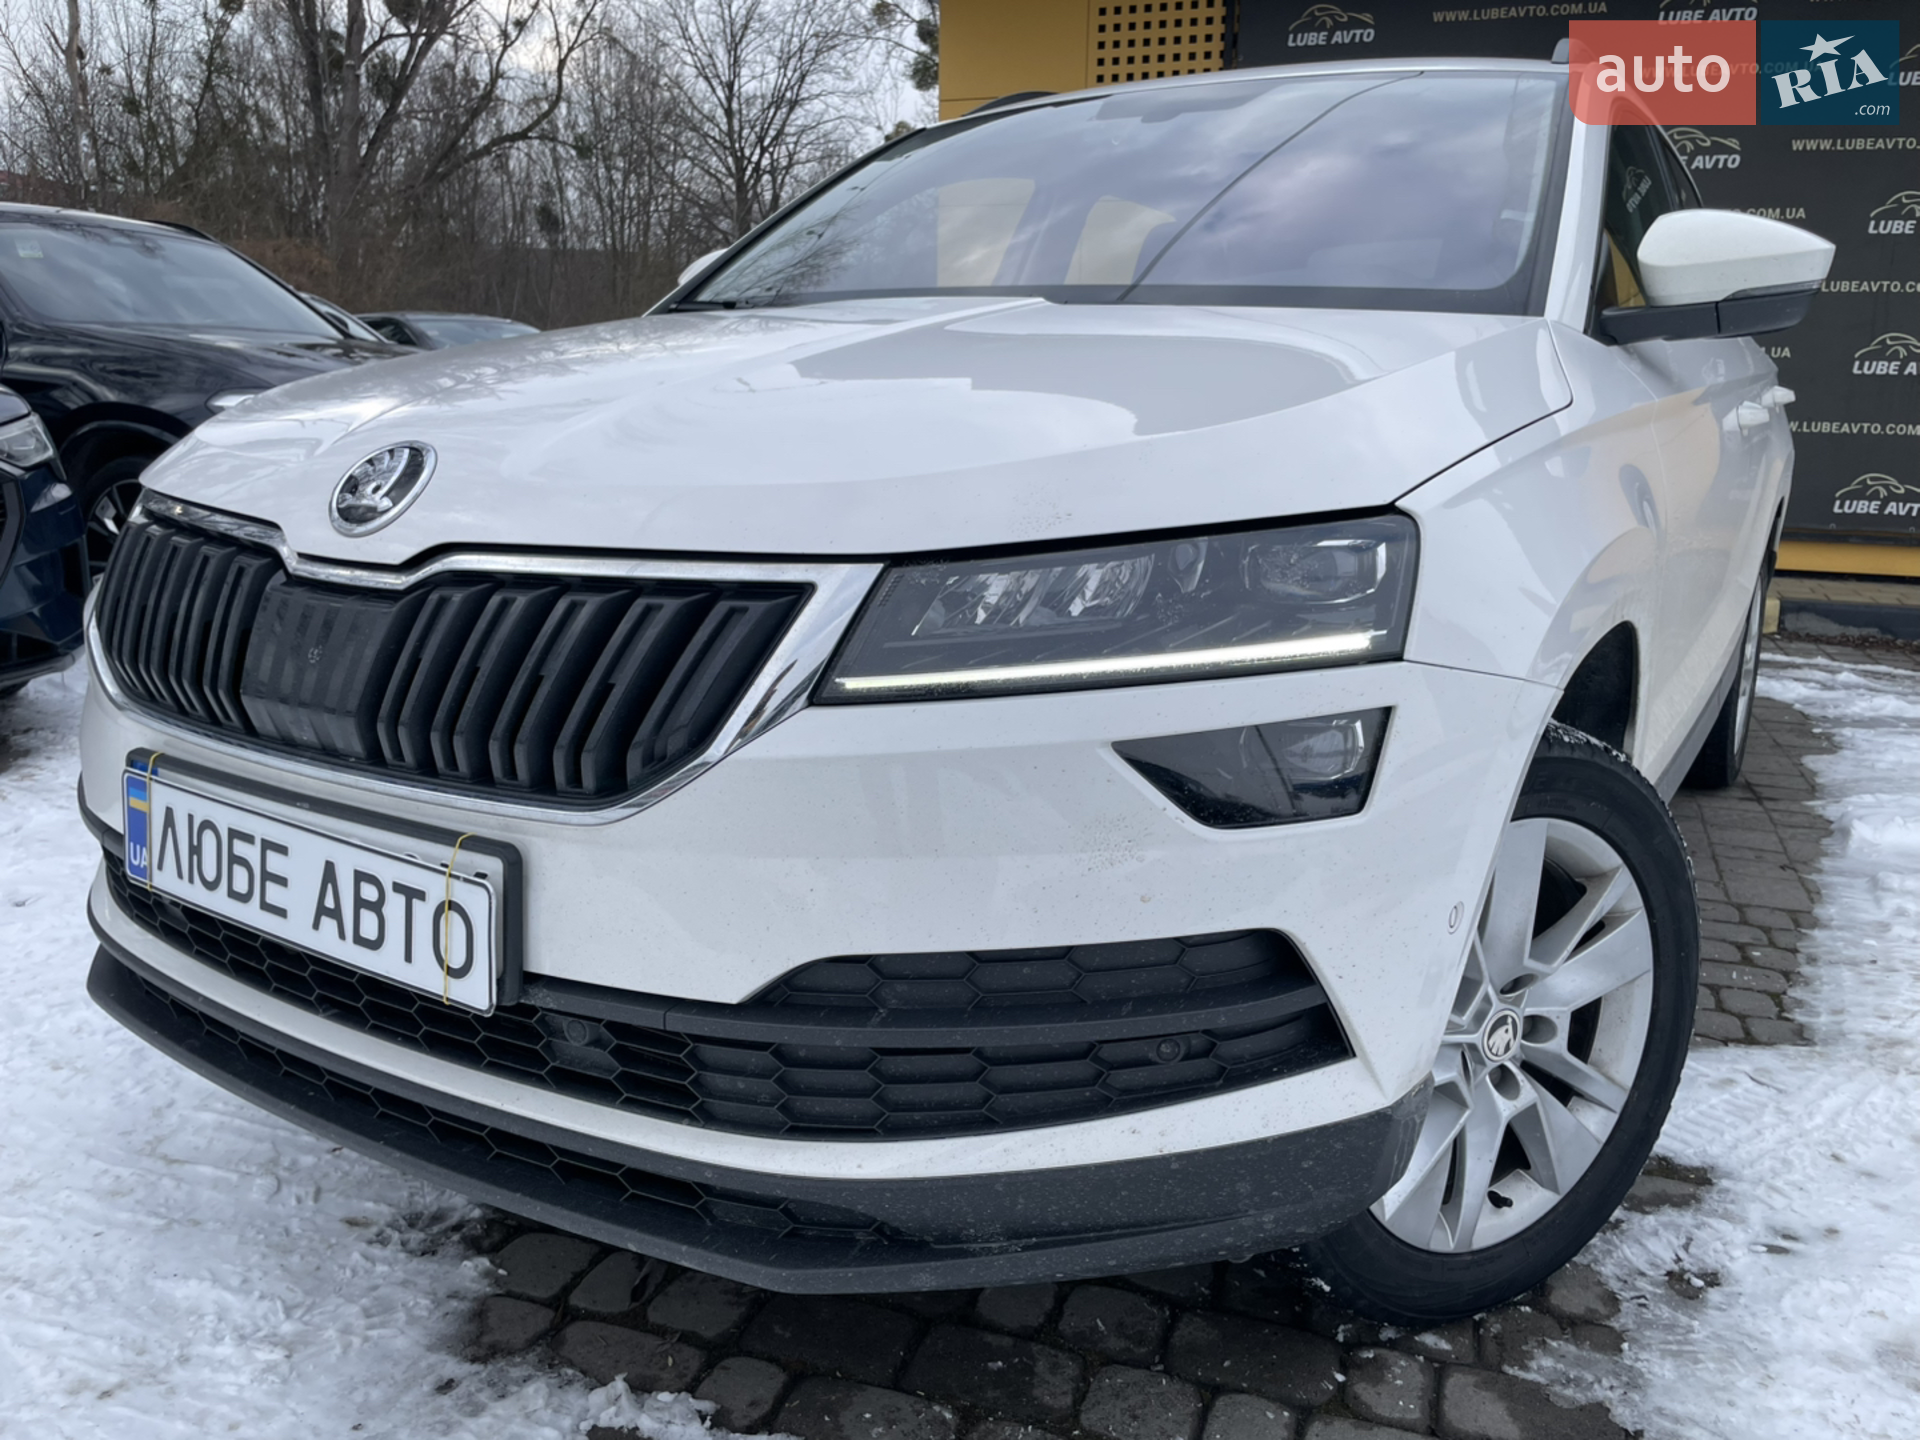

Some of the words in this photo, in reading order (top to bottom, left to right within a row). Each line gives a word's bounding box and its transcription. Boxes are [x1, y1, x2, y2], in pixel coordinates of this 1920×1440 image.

[1433, 2, 1608, 22] WWW.LUBEAVTO.COM.UA
[1707, 7, 1758, 24] AVTO
[1287, 31, 1328, 47] LUBE
[1330, 28, 1375, 45] AVTO
[1690, 154, 1741, 170] AVTO
[1867, 219, 1917, 235] LUBE
[1852, 360, 1901, 375] LUBE
[1832, 499, 1882, 515] LUBE
[157, 805, 289, 920] ЛЮБЕ
[311, 859, 475, 980] АВТО
